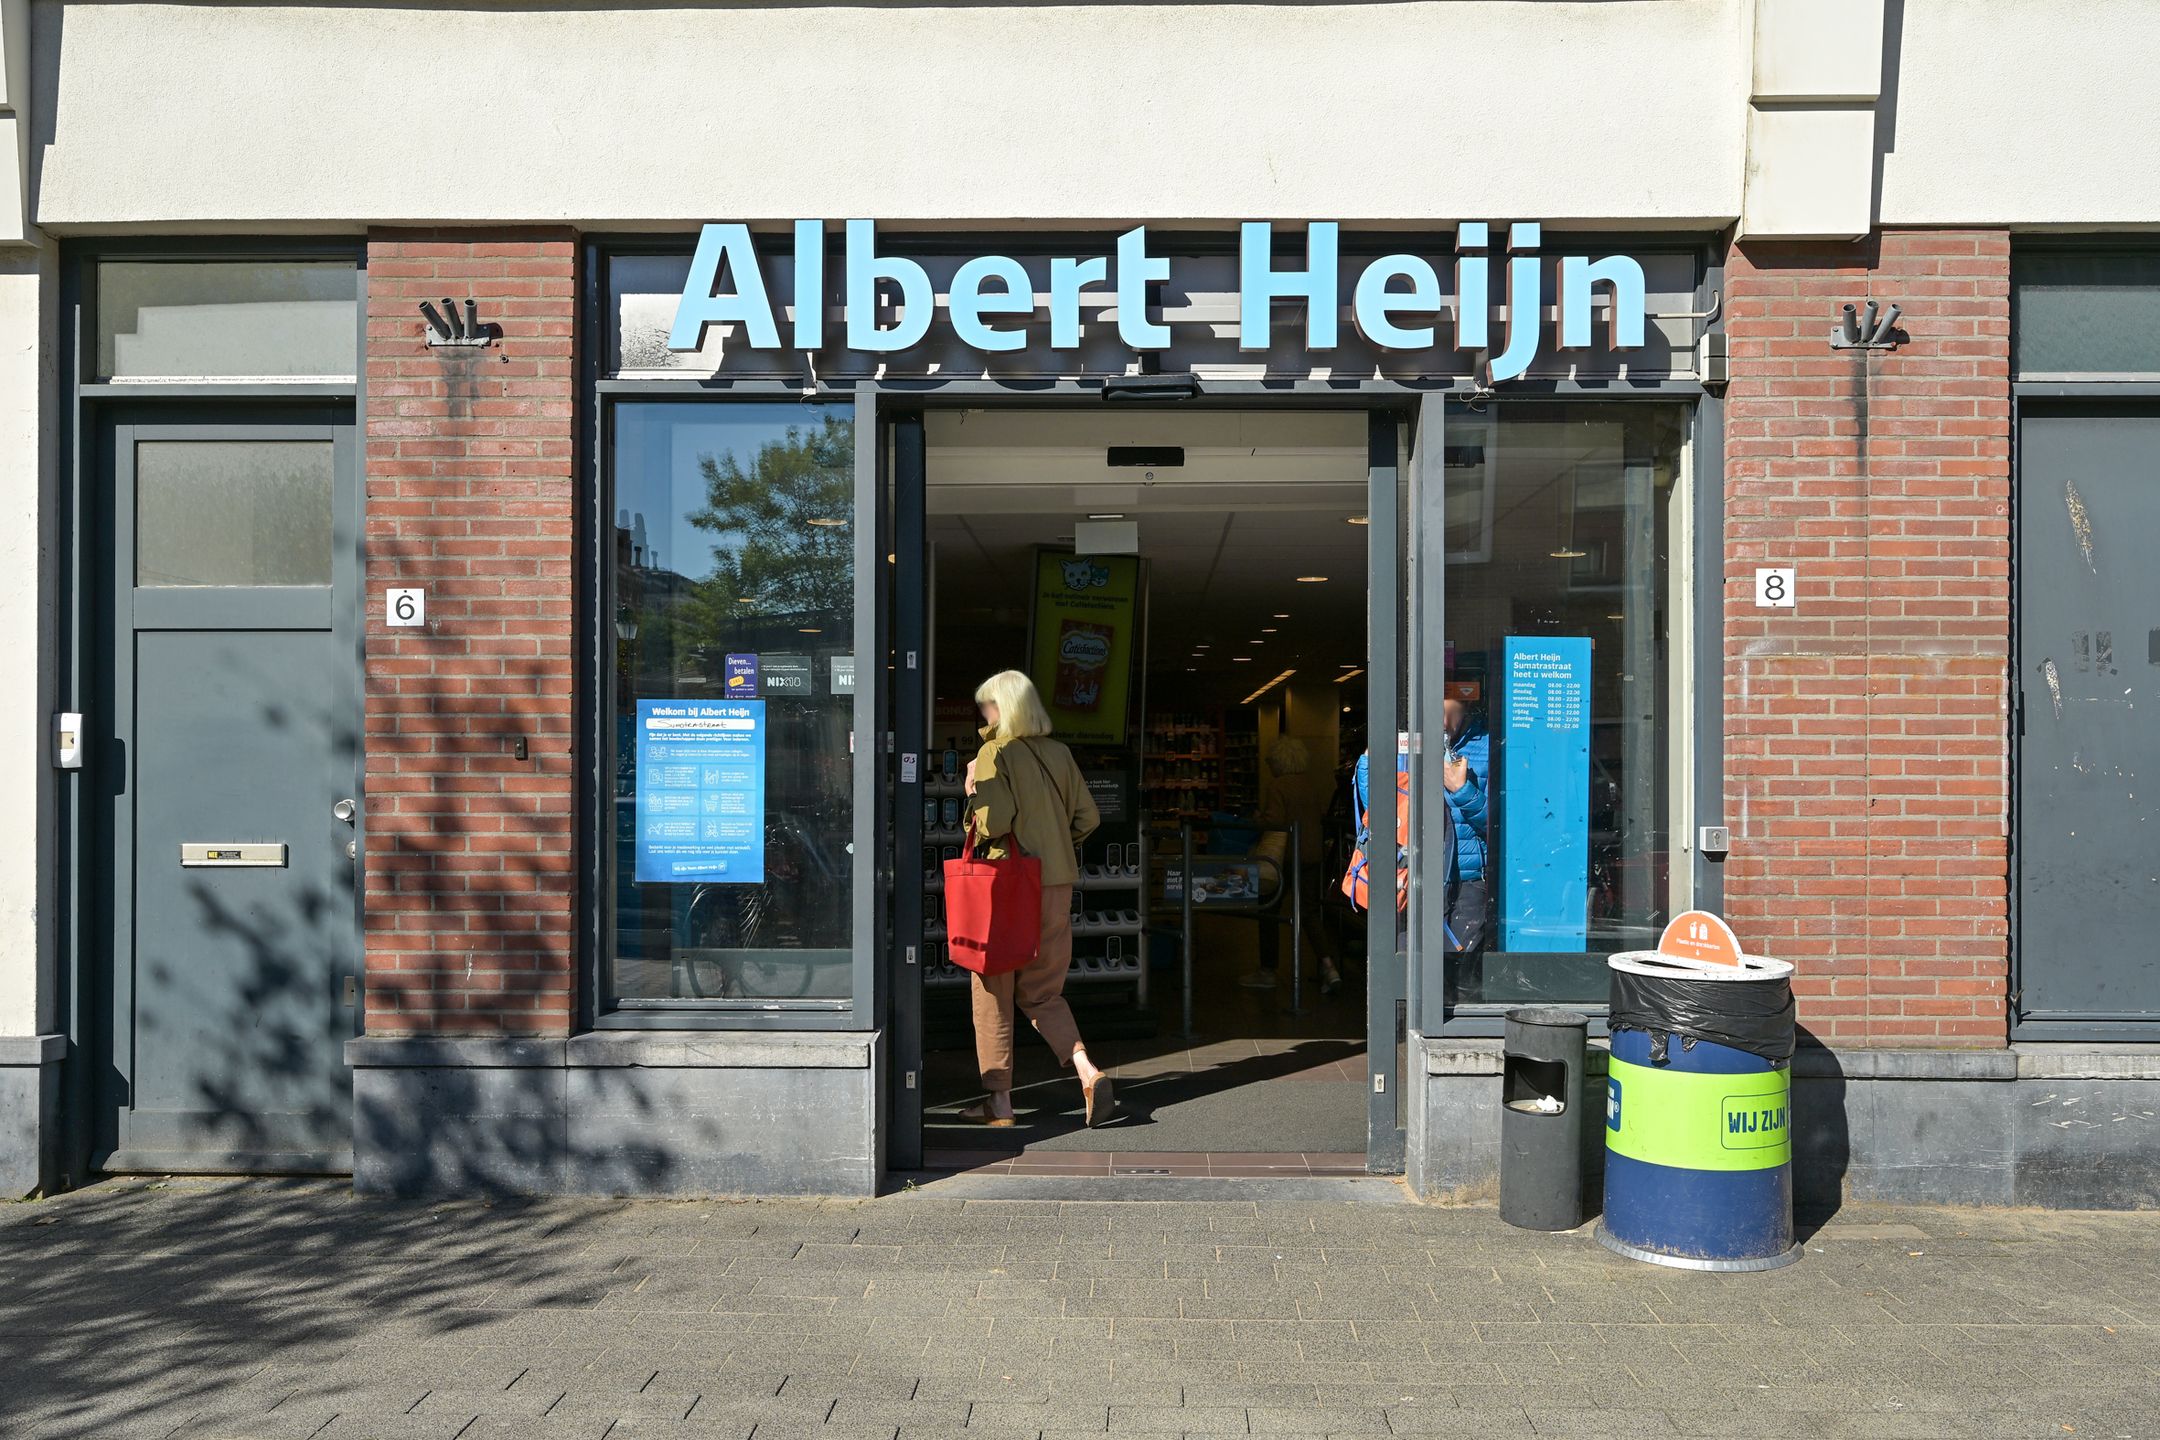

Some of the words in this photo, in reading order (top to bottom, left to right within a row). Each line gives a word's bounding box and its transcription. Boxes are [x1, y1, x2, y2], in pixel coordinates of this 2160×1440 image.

[667, 219, 1171, 353] Albert
[1240, 221, 1646, 382] Heijn
[1764, 575, 1786, 601] 8
[394, 594, 416, 621] 6
[1513, 652, 1539, 661] Albert
[1540, 653, 1561, 663] Heijn
[1513, 661, 1572, 670] Sumatrastraat
[733, 667, 755, 675] betalen
[652, 707, 686, 716] Welkom
[687, 707, 698, 718] bij
[700, 707, 727, 716] Albert
[728, 707, 750, 718] Heijn
[1728, 1111, 1757, 1133] WIJ
[1761, 1107, 1786, 1132] ZIJN
